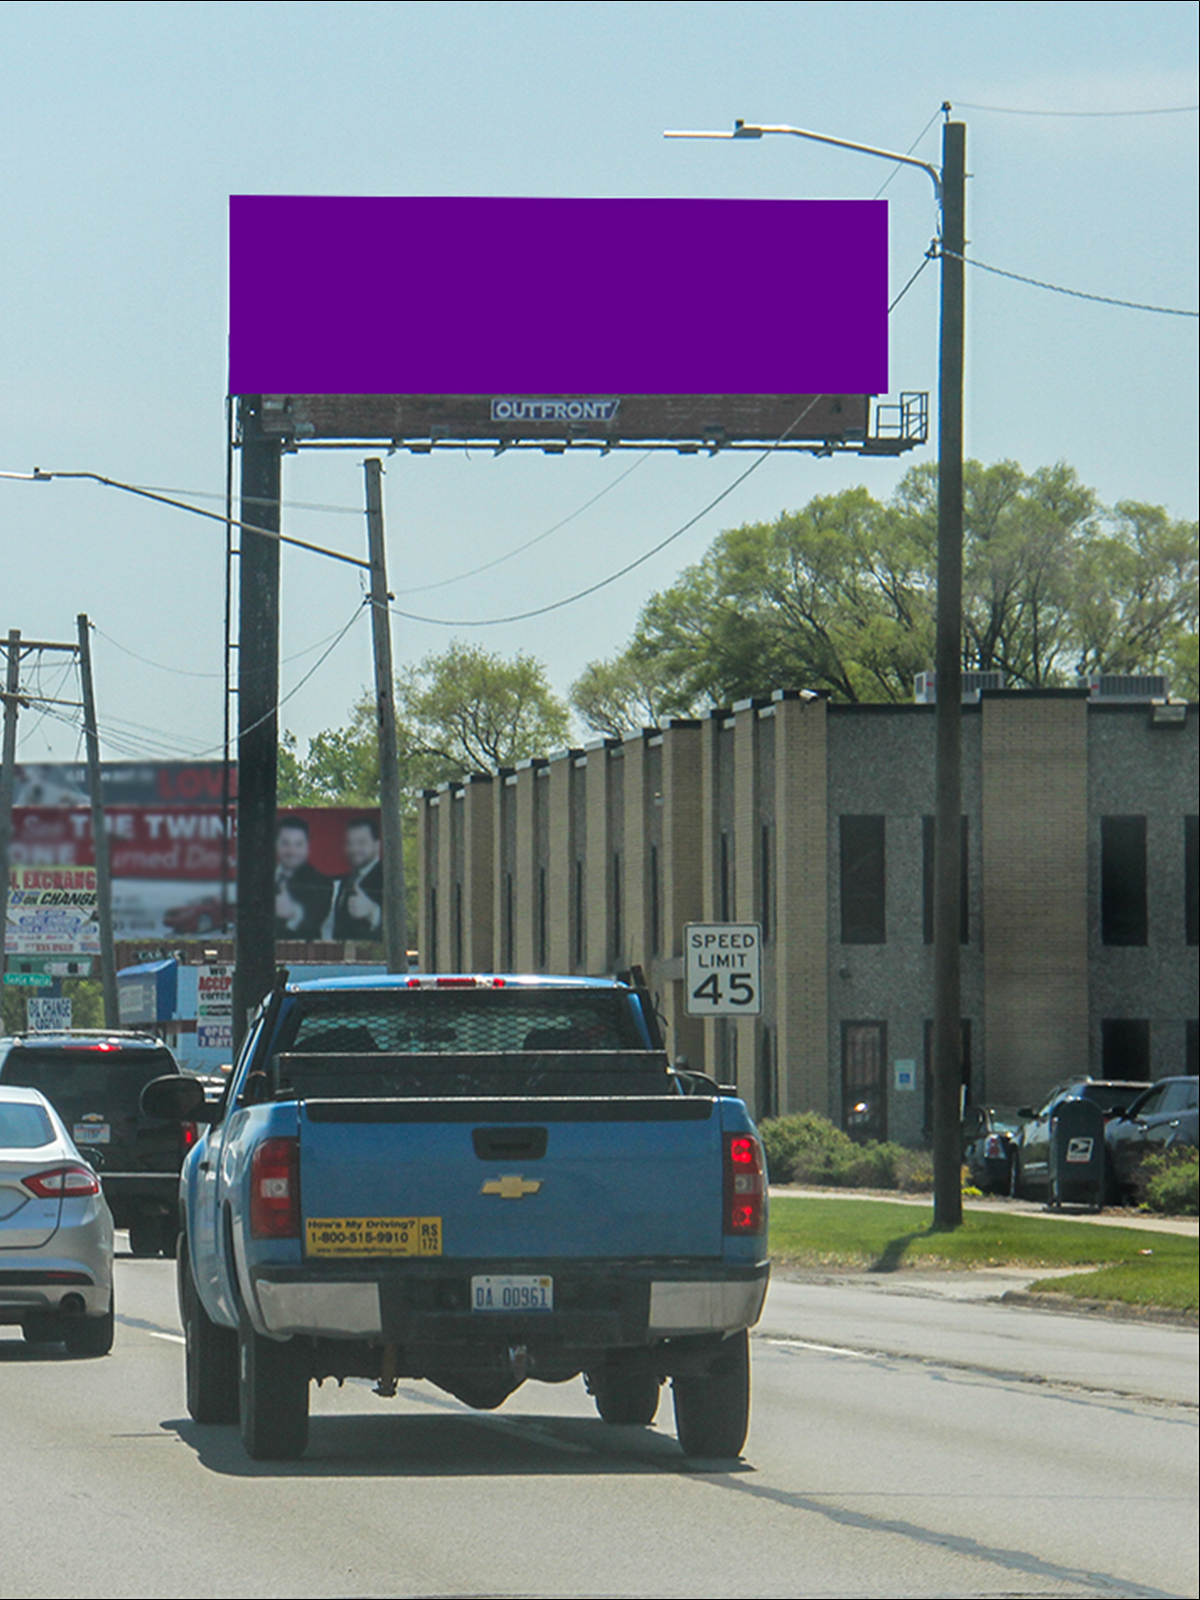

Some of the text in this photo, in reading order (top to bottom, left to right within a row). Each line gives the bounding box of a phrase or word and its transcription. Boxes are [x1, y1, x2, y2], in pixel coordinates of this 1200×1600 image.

[495, 401, 612, 418] OUTFRONT
[144, 814, 238, 840] TWIN
[22, 869, 97, 891] EXCHANG
[40, 892, 98, 906] CHANGE
[691, 934, 755, 948] SPEED
[698, 954, 747, 968] LIMIT
[198, 976, 232, 991] ACCEP
[693, 973, 755, 1006] 45
[42, 999, 71, 1018] CHANGE
[308, 1219, 416, 1231] How's My Driving?
[421, 1223, 438, 1237] RS
[311, 1231, 409, 1243] 1-800-515-9910
[422, 1238, 438, 1250] 172
[476, 1286, 547, 1307] DA 00961
